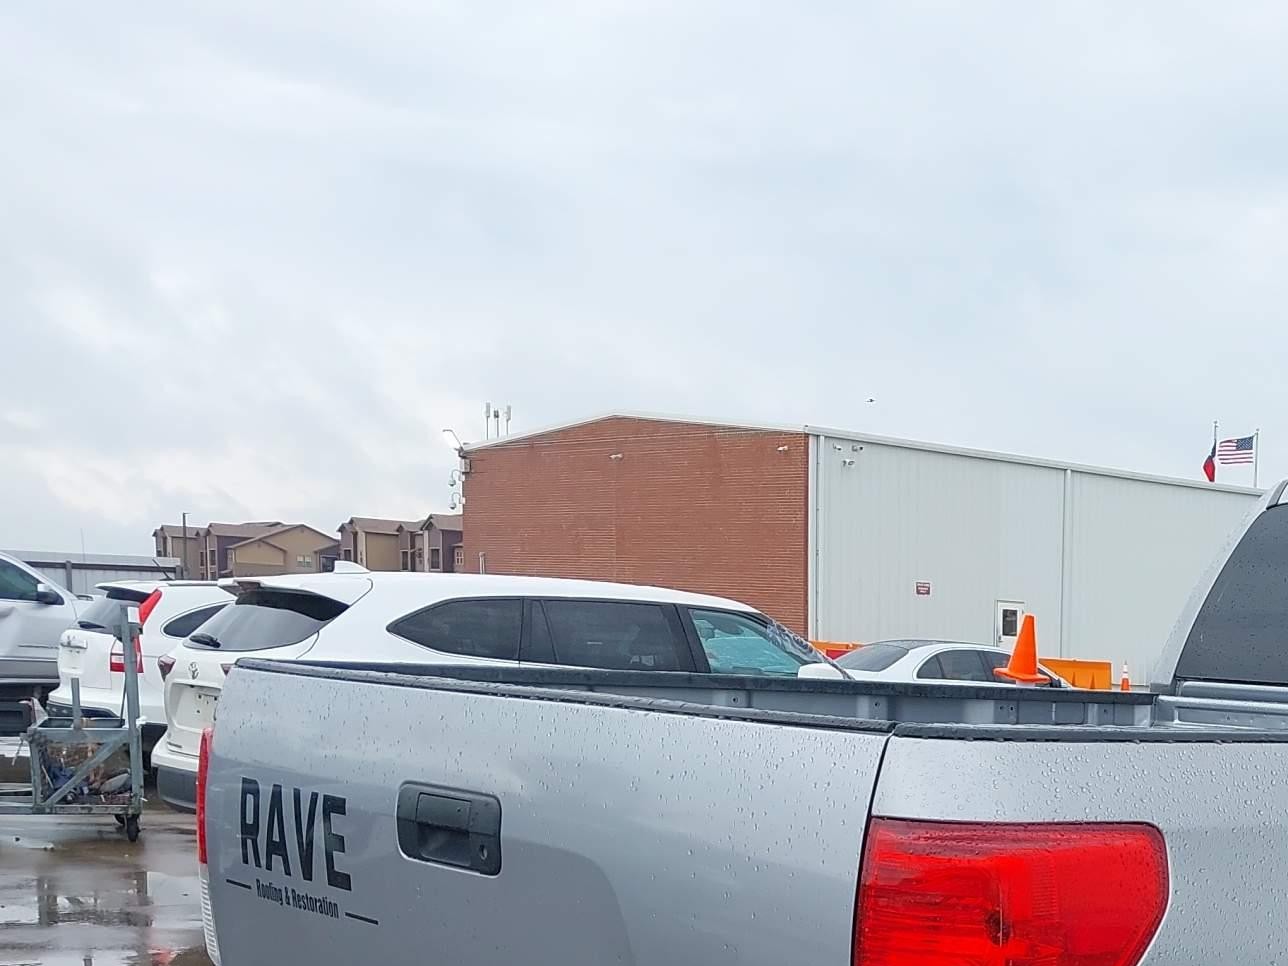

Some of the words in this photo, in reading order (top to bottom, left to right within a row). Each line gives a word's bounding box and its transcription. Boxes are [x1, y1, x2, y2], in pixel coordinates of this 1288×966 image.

[240, 776, 352, 892] RAVE
[255, 878, 284, 906] Roofing
[284, 885, 291, 906] &
[291, 888, 340, 919] Restoration
